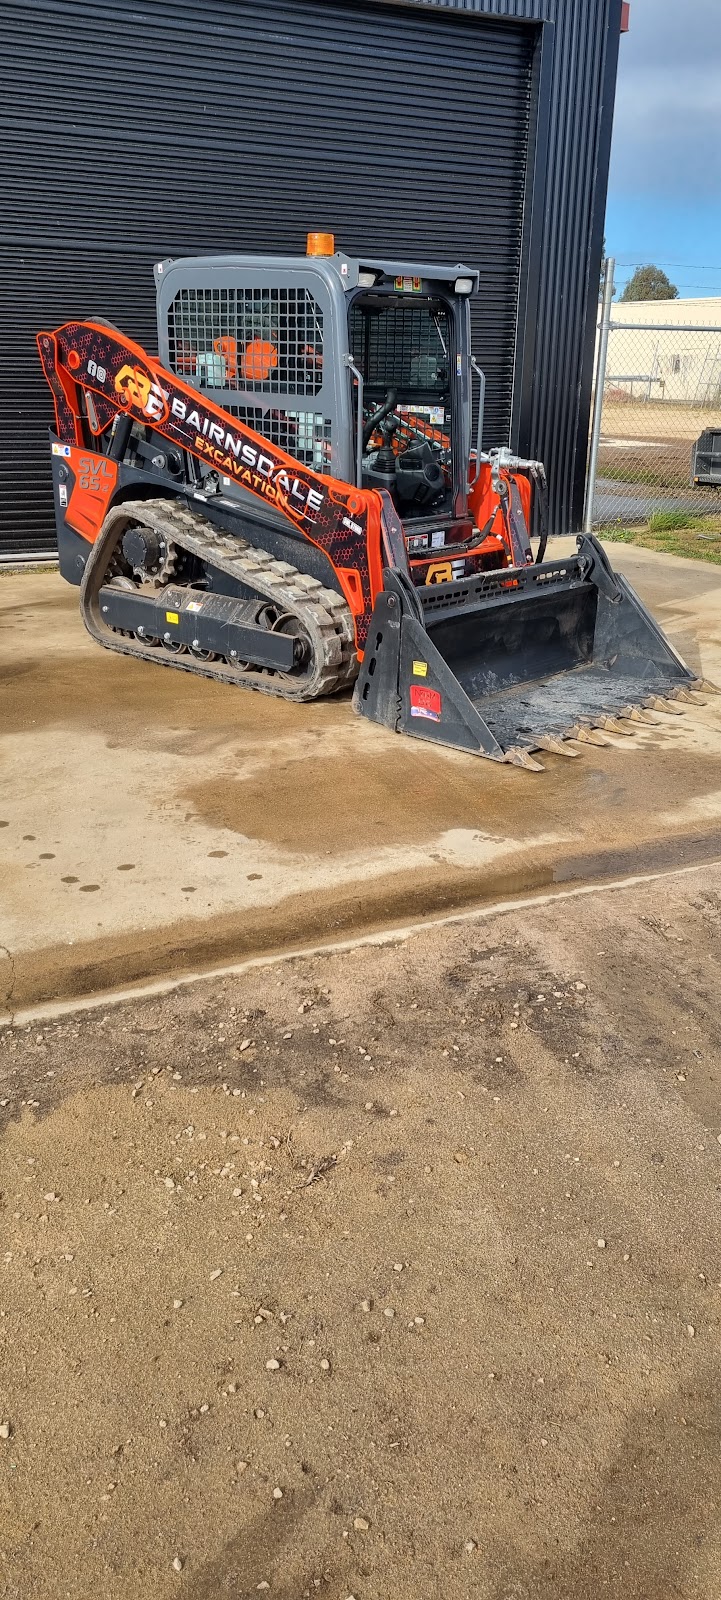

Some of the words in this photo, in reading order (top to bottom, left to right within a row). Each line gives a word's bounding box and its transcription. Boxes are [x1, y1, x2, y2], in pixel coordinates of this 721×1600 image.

[78, 457, 113, 479] SVL
[171, 397, 325, 512] BAIRNSDALE
[194, 435, 289, 509] EXCAVATION
